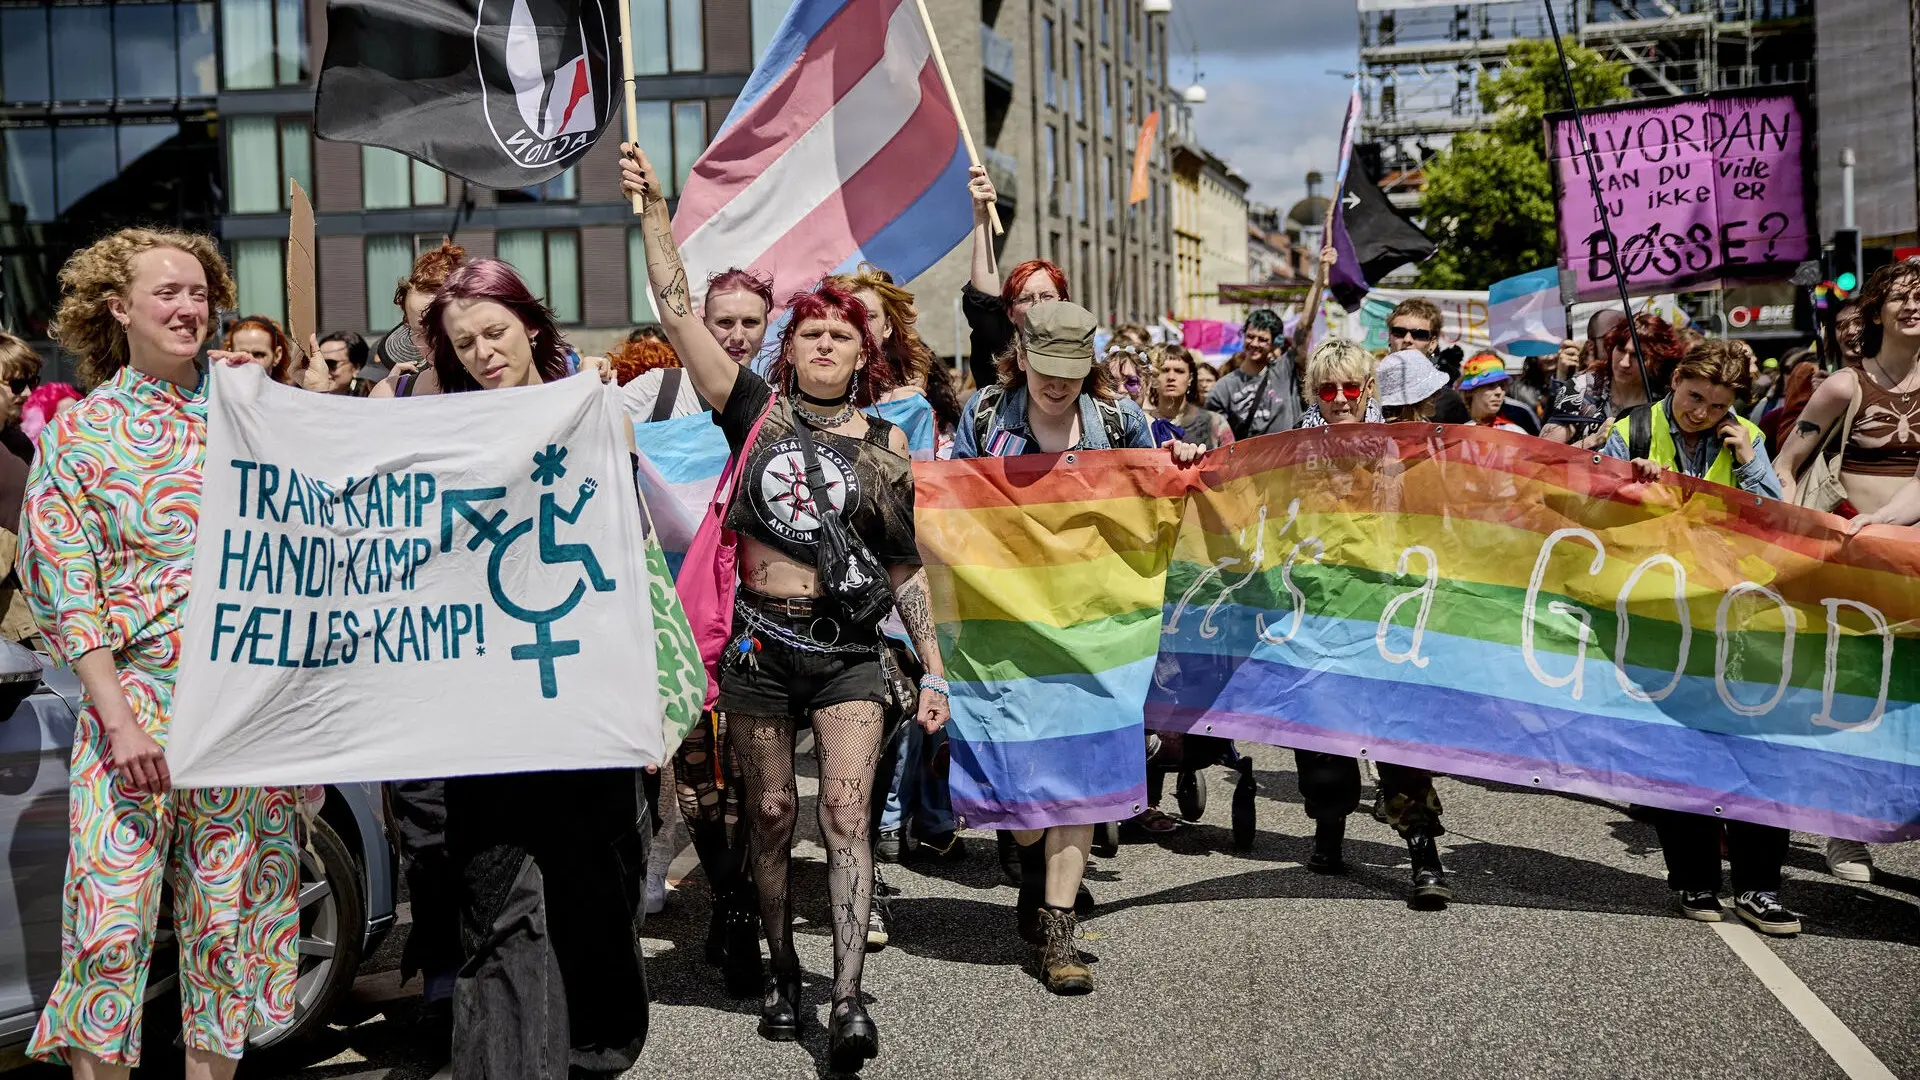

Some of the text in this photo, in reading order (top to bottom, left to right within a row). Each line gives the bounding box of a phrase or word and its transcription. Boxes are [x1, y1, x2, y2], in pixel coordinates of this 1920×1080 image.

[1567, 111, 1790, 176] HVORDAN
[1659, 163, 1690, 186] DU
[1719, 156, 1770, 179] vide
[1594, 198, 1624, 223] DU
[230, 459, 436, 528] TRANS-KAMP
[772, 440, 857, 492] TRAKAOTISK
[768, 518, 814, 542] AKTION
[218, 528, 432, 597] HANDI-KAMP
[1375, 545, 1438, 669] a
[1521, 527, 1895, 733] GOOD
